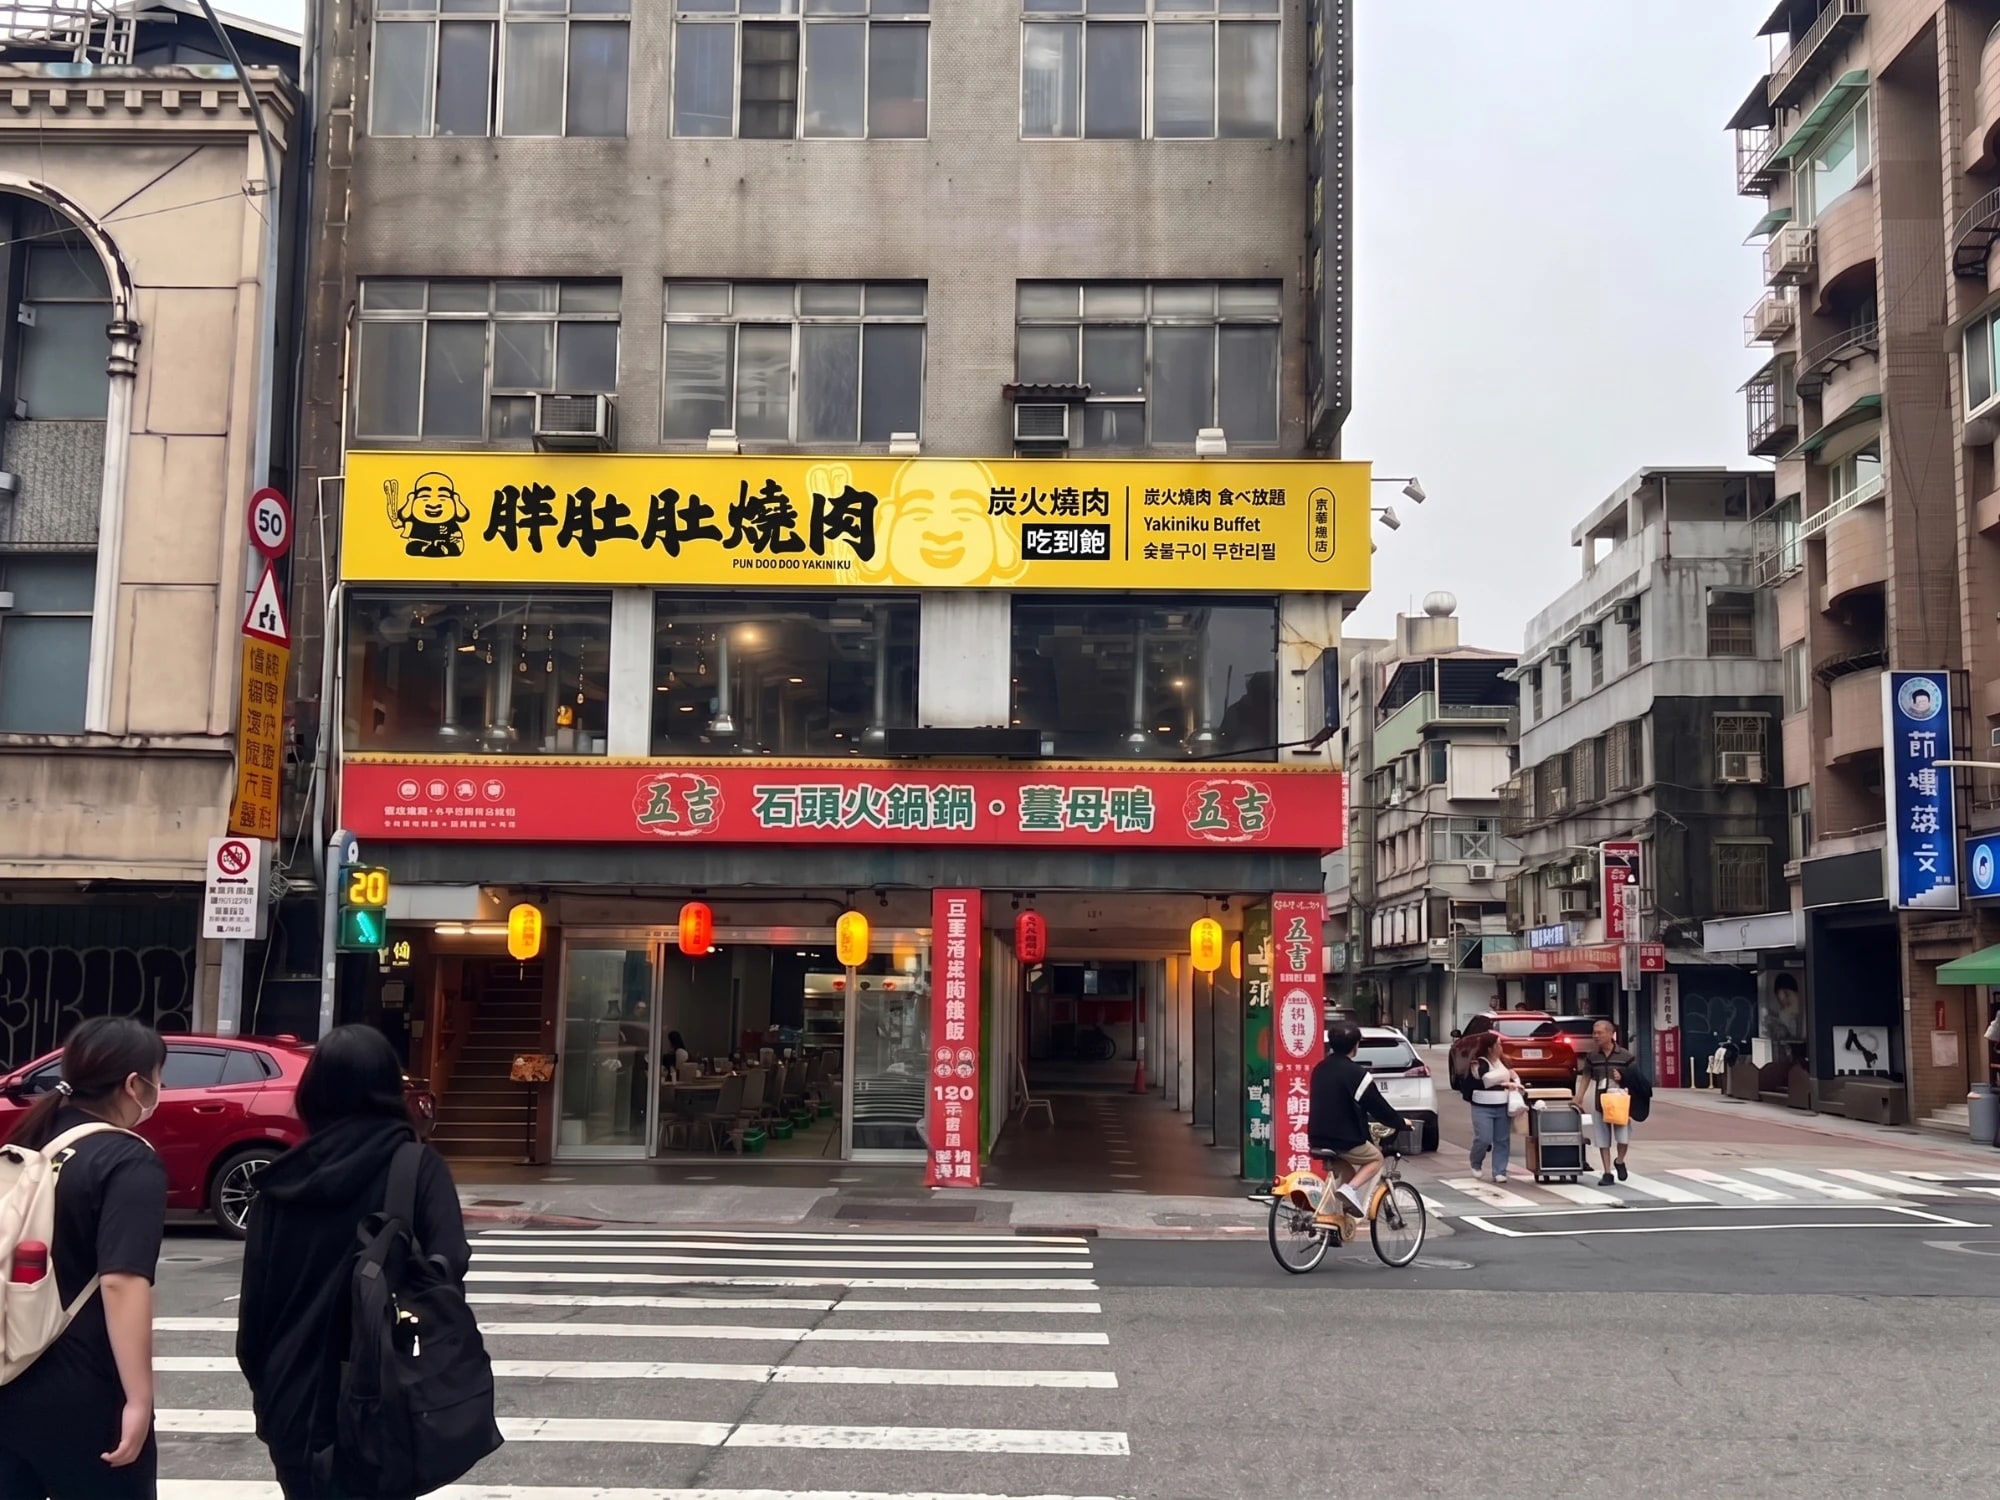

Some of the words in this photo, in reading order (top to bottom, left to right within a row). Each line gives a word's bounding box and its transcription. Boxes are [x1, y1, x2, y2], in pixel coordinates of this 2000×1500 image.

[987, 486, 1110, 517] 炭火燒肉
[1143, 487, 1211, 506] 炭火燒肉
[1217, 488, 1286, 507] 食べ放題
[257, 508, 282, 537] 50
[482, 478, 880, 562] 胖肚肚燒肉
[1143, 516, 1209, 533] Yakiniku
[1213, 517, 1261, 533] Buffet
[1026, 527, 1106, 555] 吃到飽
[1143, 542, 1206, 561] 숯불구이
[1212, 542, 1277, 562] 무한리필
[732, 558, 753, 570] PUN
[755, 558, 778, 571] DOO
[778, 559, 800, 571] DOO
[801, 559, 851, 572] YAKINIKU
[639, 782, 721, 826] 五吉
[1189, 785, 1270, 834] 五吉
[350, 872, 385, 903] 20
[934, 1085, 974, 1101] 120
